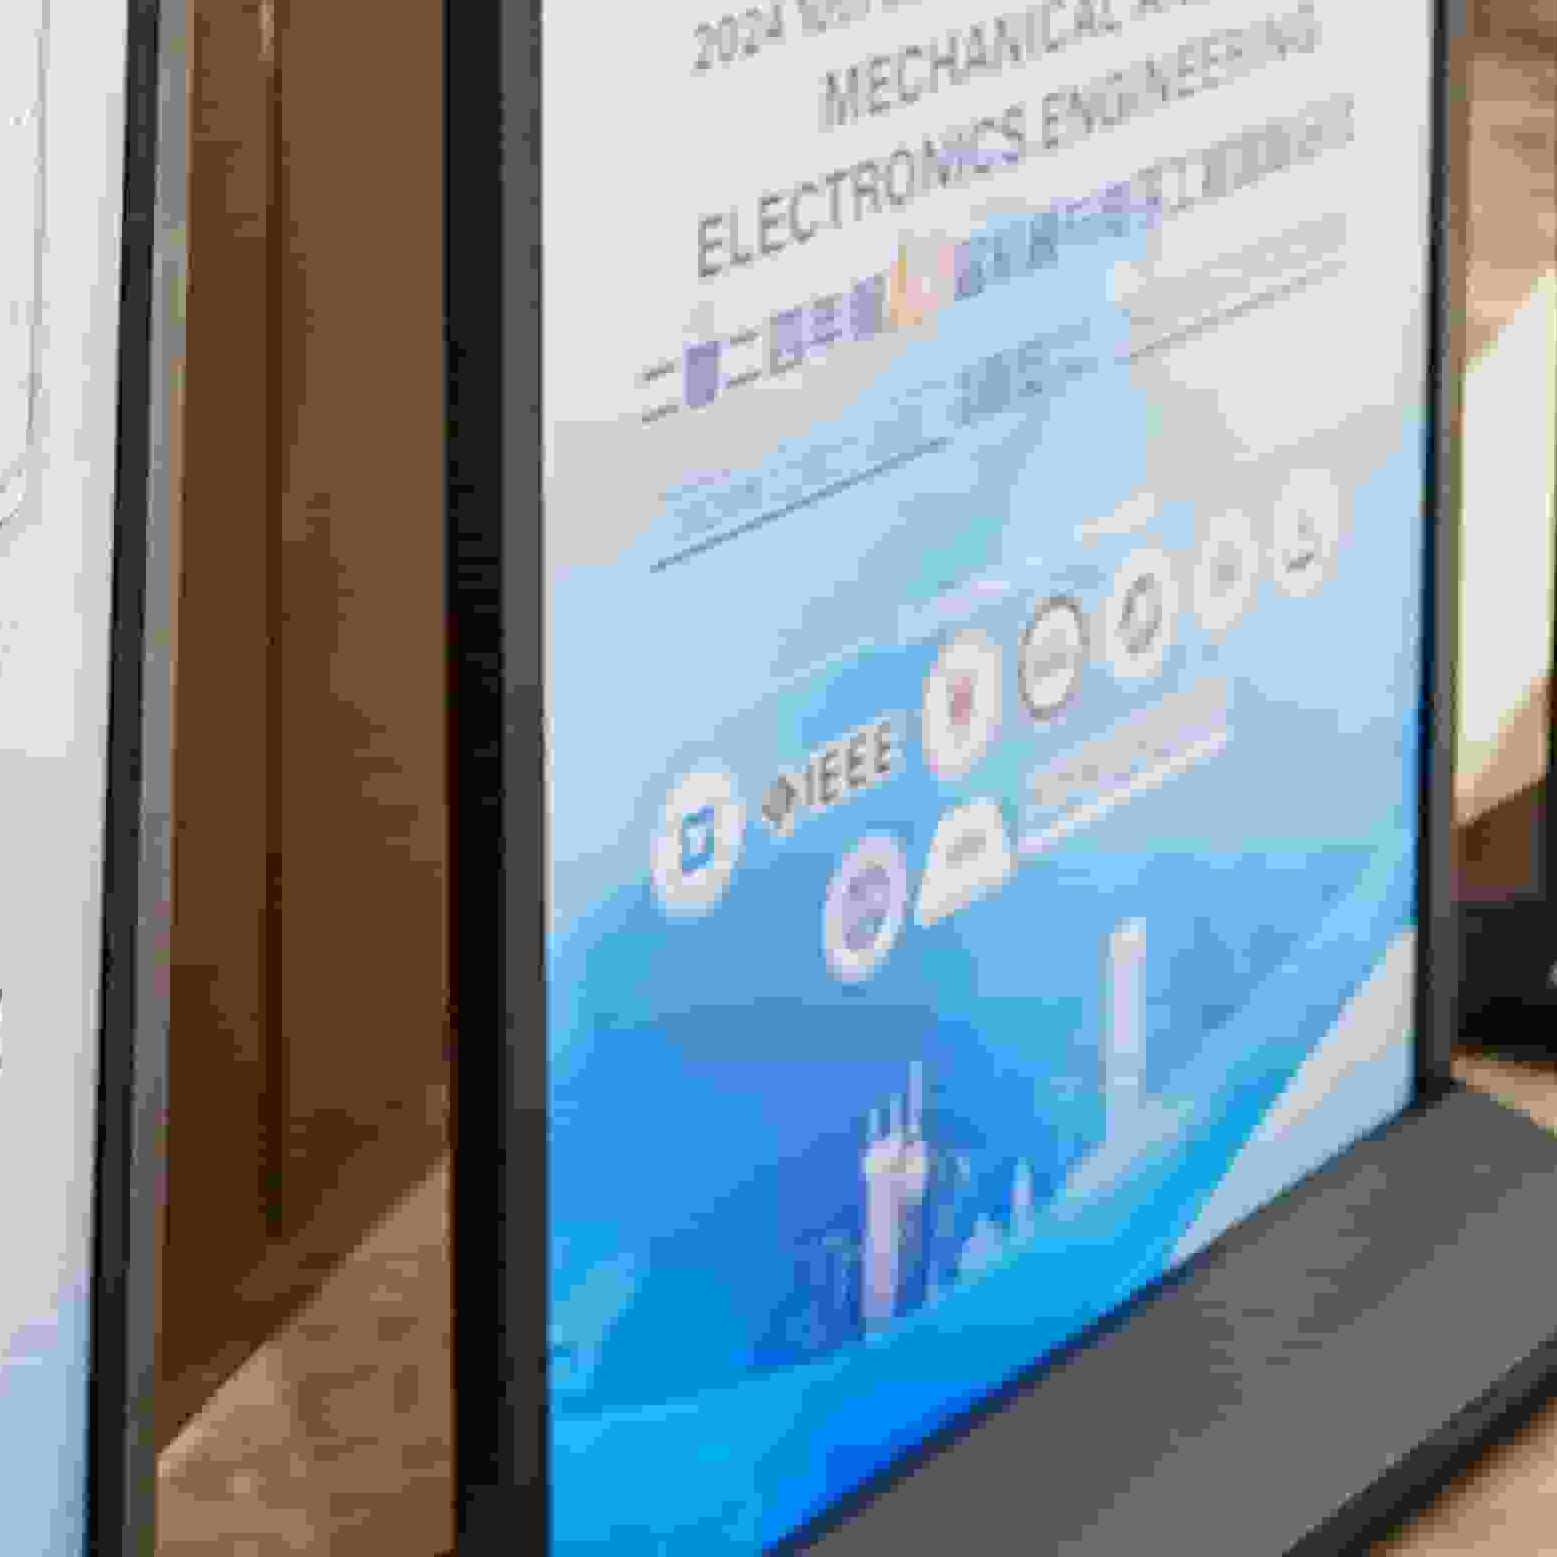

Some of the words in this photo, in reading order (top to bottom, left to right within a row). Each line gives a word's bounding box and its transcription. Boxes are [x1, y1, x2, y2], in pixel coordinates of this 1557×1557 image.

[696, 107, 1026, 278] ELECTRONICS
[1040, 3, 1316, 149] ENGINEERING
[803, 721, 893, 811] IEEE
